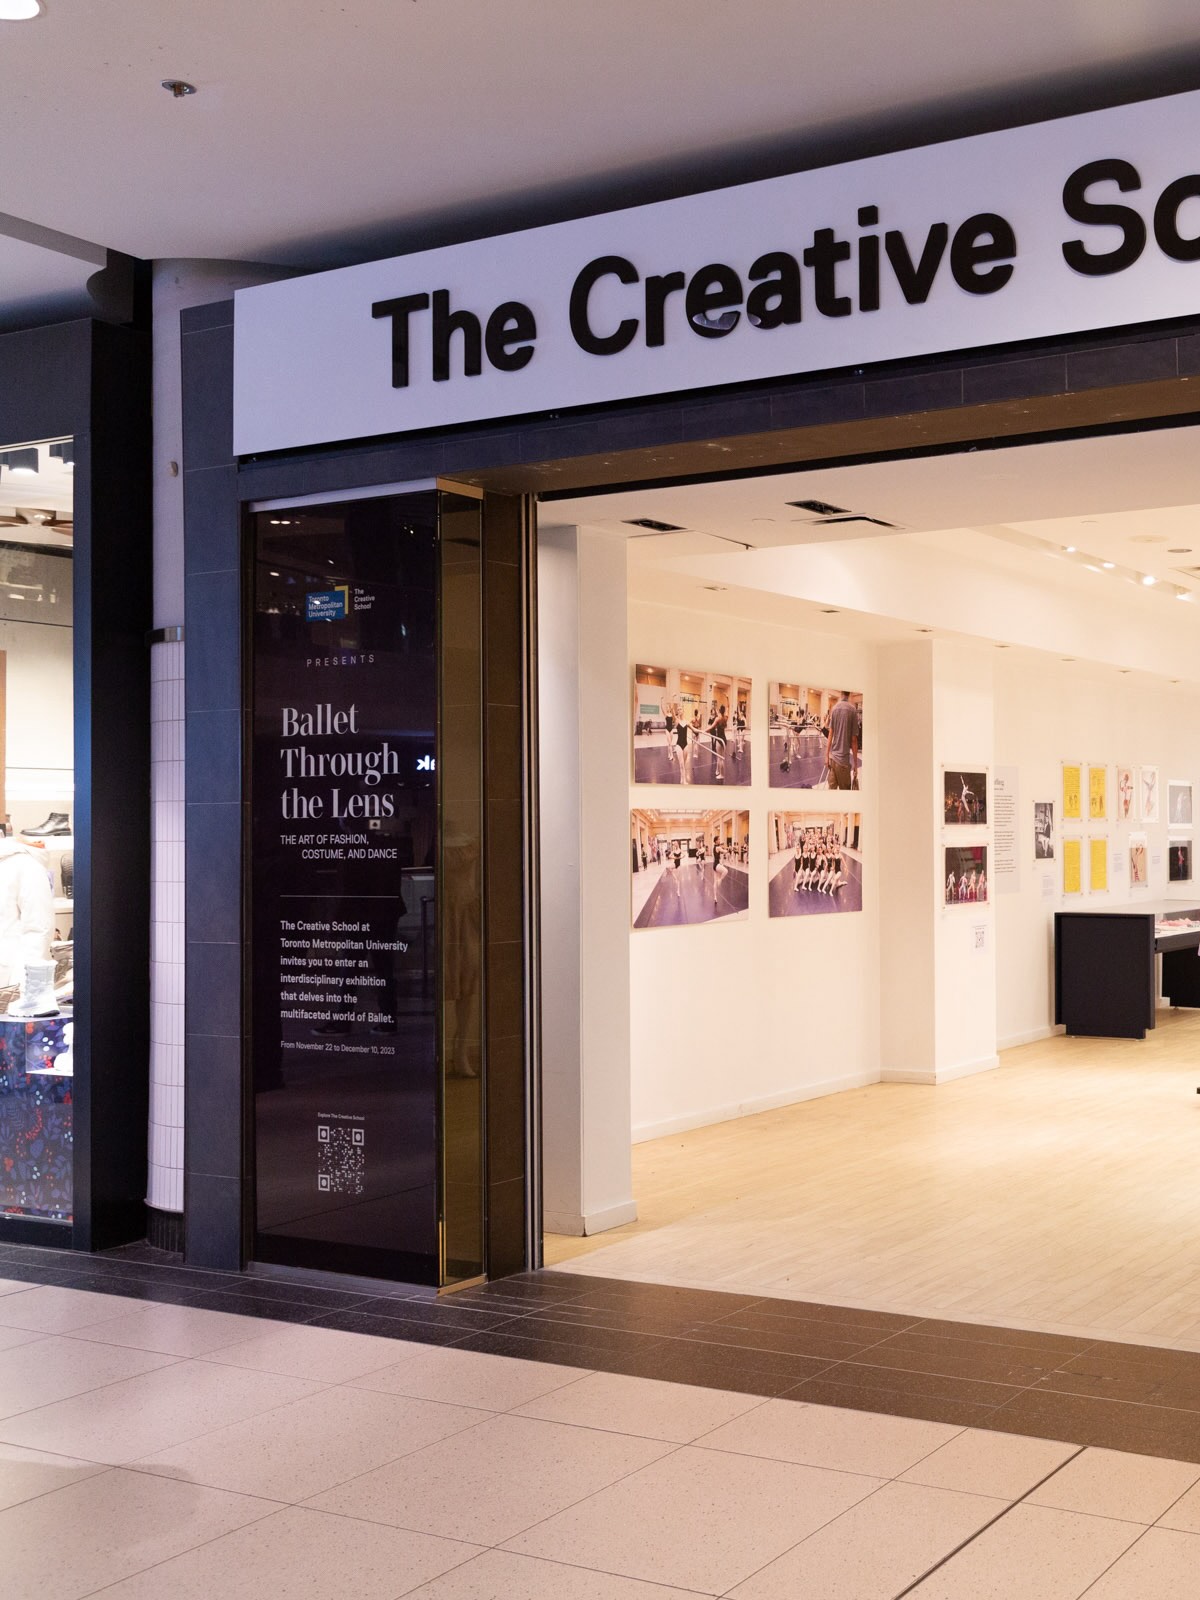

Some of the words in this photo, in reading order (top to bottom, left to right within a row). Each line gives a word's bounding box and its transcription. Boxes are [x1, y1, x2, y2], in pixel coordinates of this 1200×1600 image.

[372, 289, 536, 388] The
[569, 203, 1016, 356] Creative
[309, 602, 342, 610] Metropolitan
[307, 654, 374, 667] PRESENTS
[280, 703, 359, 737] Ballet
[280, 743, 400, 785] Through
[280, 787, 323, 819] the
[331, 788, 395, 818] Lens
[280, 835, 296, 844] THE
[298, 835, 314, 844] ART
[317, 835, 328, 844] OF
[330, 834, 369, 844] FASHION,
[302, 849, 346, 859] COSTUME,
[348, 849, 366, 858] AND
[368, 849, 397, 858] DANCE
[280, 921, 295, 930] The
[297, 921, 330, 930] Creative
[332, 921, 359, 931] School
[362, 923, 370, 931] at
[281, 938, 310, 948] Toronto
[313, 939, 363, 951] Metropolitan
[366, 940, 408, 952] University
[281, 956, 306, 965] invites
[308, 959, 322, 967] you
[324, 958, 333, 966] to
[335, 959, 356, 967] enter
[281, 973, 344, 986] interdisciplinary
[346, 976, 385, 986] exhibition
[281, 991, 297, 1000] that
[299, 992, 324, 1001] delves
[326, 993, 341, 1002] into
[344, 994, 357, 1003] the
[281, 1009, 330, 1020] multifaceted
[333, 1012, 355, 1021] world
[357, 1012, 365, 1021] of
[368, 1013, 394, 1023] Ballet.
[296, 1042, 324, 1050] November
[341, 1044, 369, 1053] December
[371, 1046, 379, 1054] 10,
[380, 1046, 395, 1054] 2023
